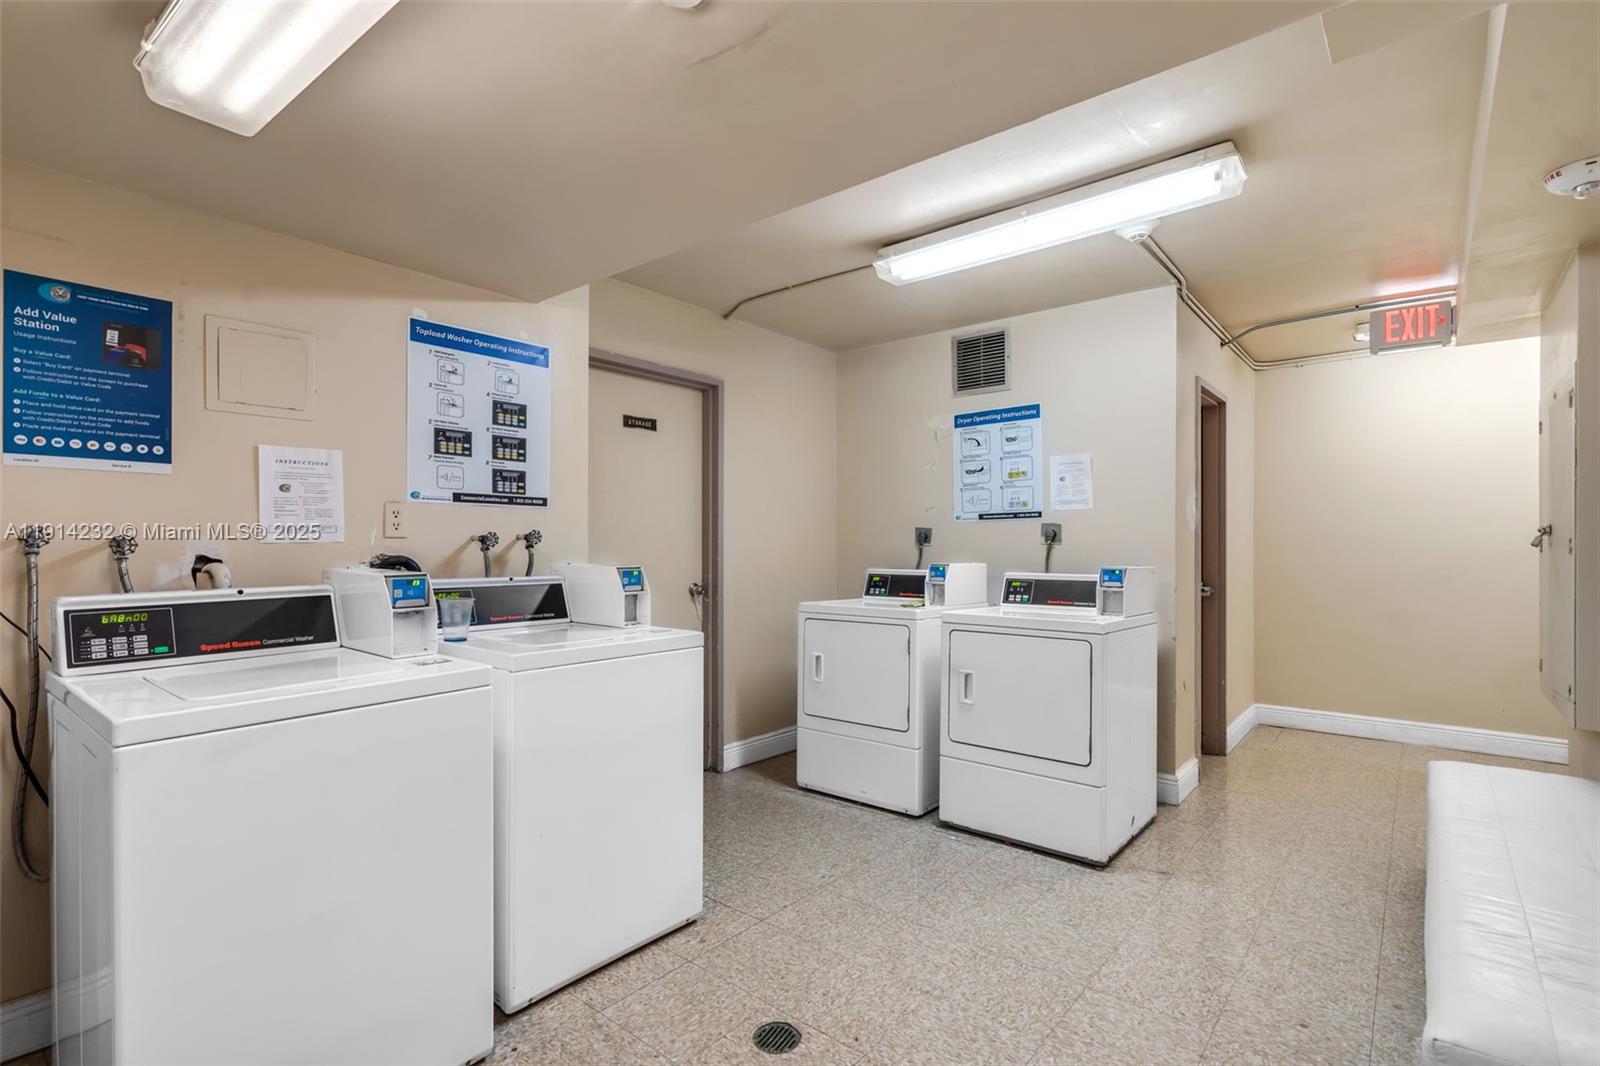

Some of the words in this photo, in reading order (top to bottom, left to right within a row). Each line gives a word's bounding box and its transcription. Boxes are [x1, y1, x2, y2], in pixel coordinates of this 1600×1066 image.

[1544, 170, 1563, 184] FIRE
[14, 306, 39, 317] Add
[42, 311, 77, 324] Value
[14, 317, 60, 332] Station
[1385, 304, 1439, 344] EXIT
[13, 330, 35, 339] Usage
[37, 333, 77, 345] Instructions
[415, 326, 446, 339] Topload
[447, 332, 473, 345] Washer
[473, 338, 508, 353] Operating
[508, 346, 545, 360] Instructions
[43, 371, 78, 380] instructions
[28, 389, 49, 397] Funds
[43, 411, 78, 419] instructions
[628, 418, 652, 427] STORAGE
[957, 417, 972, 425] Dryer
[972, 413, 1001, 422] Operating
[1002, 409, 1036, 418] Instructions
[275, 458, 329, 466] INSTRUCTIONS
[200, 642, 231, 652] Speed
[232, 640, 261, 648] Queen
[262, 637, 294, 645] Commercial
